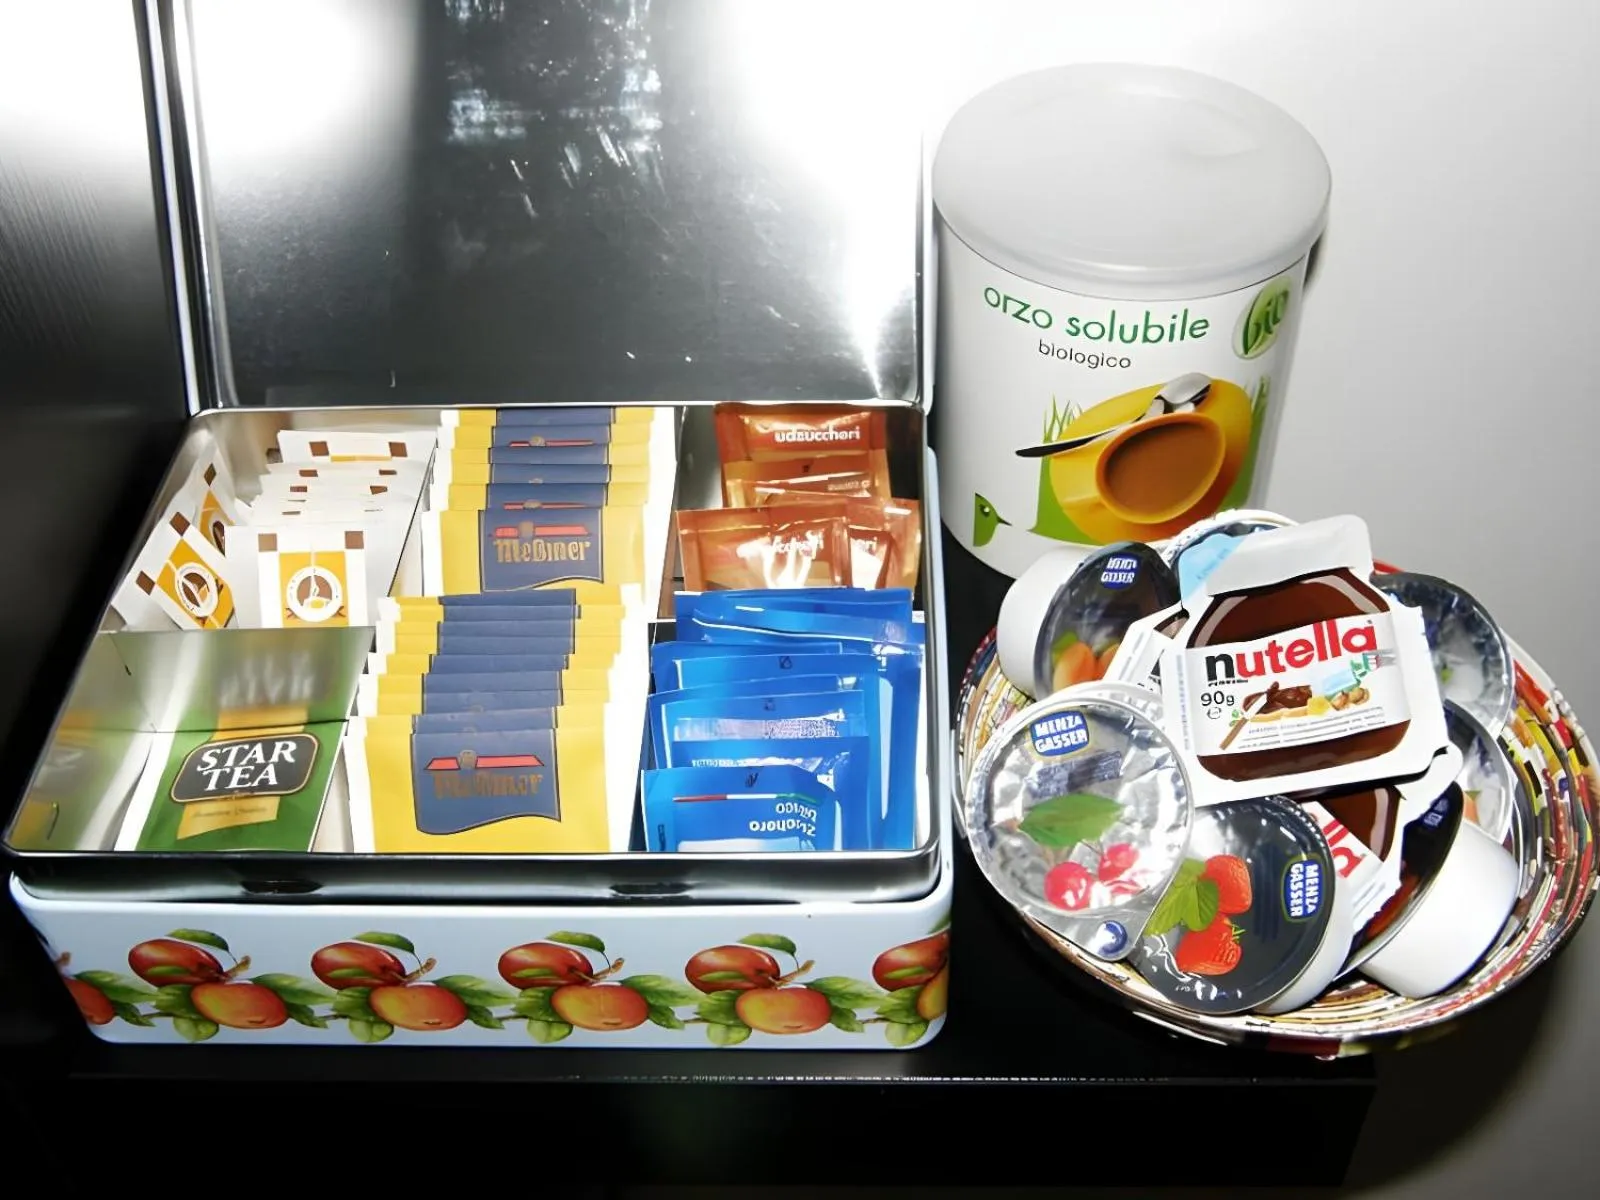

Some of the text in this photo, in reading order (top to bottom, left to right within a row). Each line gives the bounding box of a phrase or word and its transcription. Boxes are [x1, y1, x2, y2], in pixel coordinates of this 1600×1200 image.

[984, 286, 1210, 344] orzo solubile
[1038, 338, 1132, 369] biologico
[1205, 618, 1378, 682] nutella
[196, 740, 298, 773] STAR
[202, 763, 279, 793] TEA
